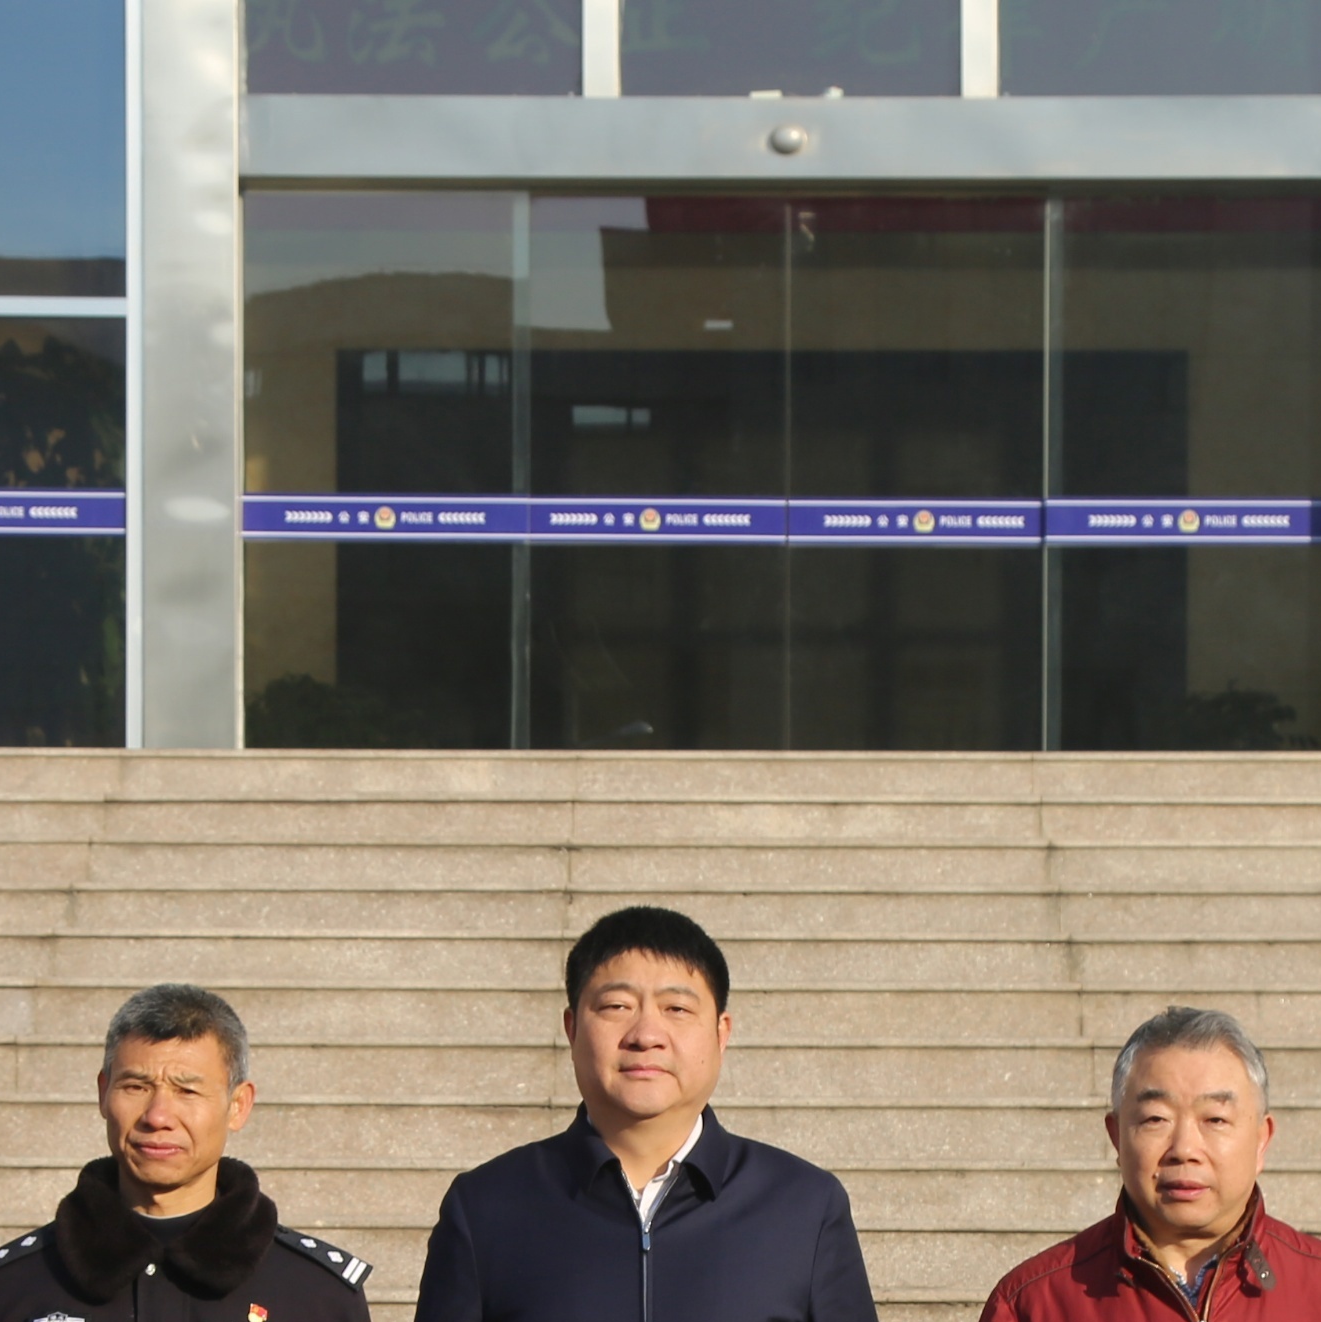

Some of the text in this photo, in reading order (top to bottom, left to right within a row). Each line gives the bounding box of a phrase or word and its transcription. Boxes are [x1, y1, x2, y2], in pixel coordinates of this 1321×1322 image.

[400, 511, 434, 525] POLICE
[665, 513, 699, 527] POLICE
[939, 514, 973, 528] POLICE
[1204, 514, 1238, 528] POLICE
